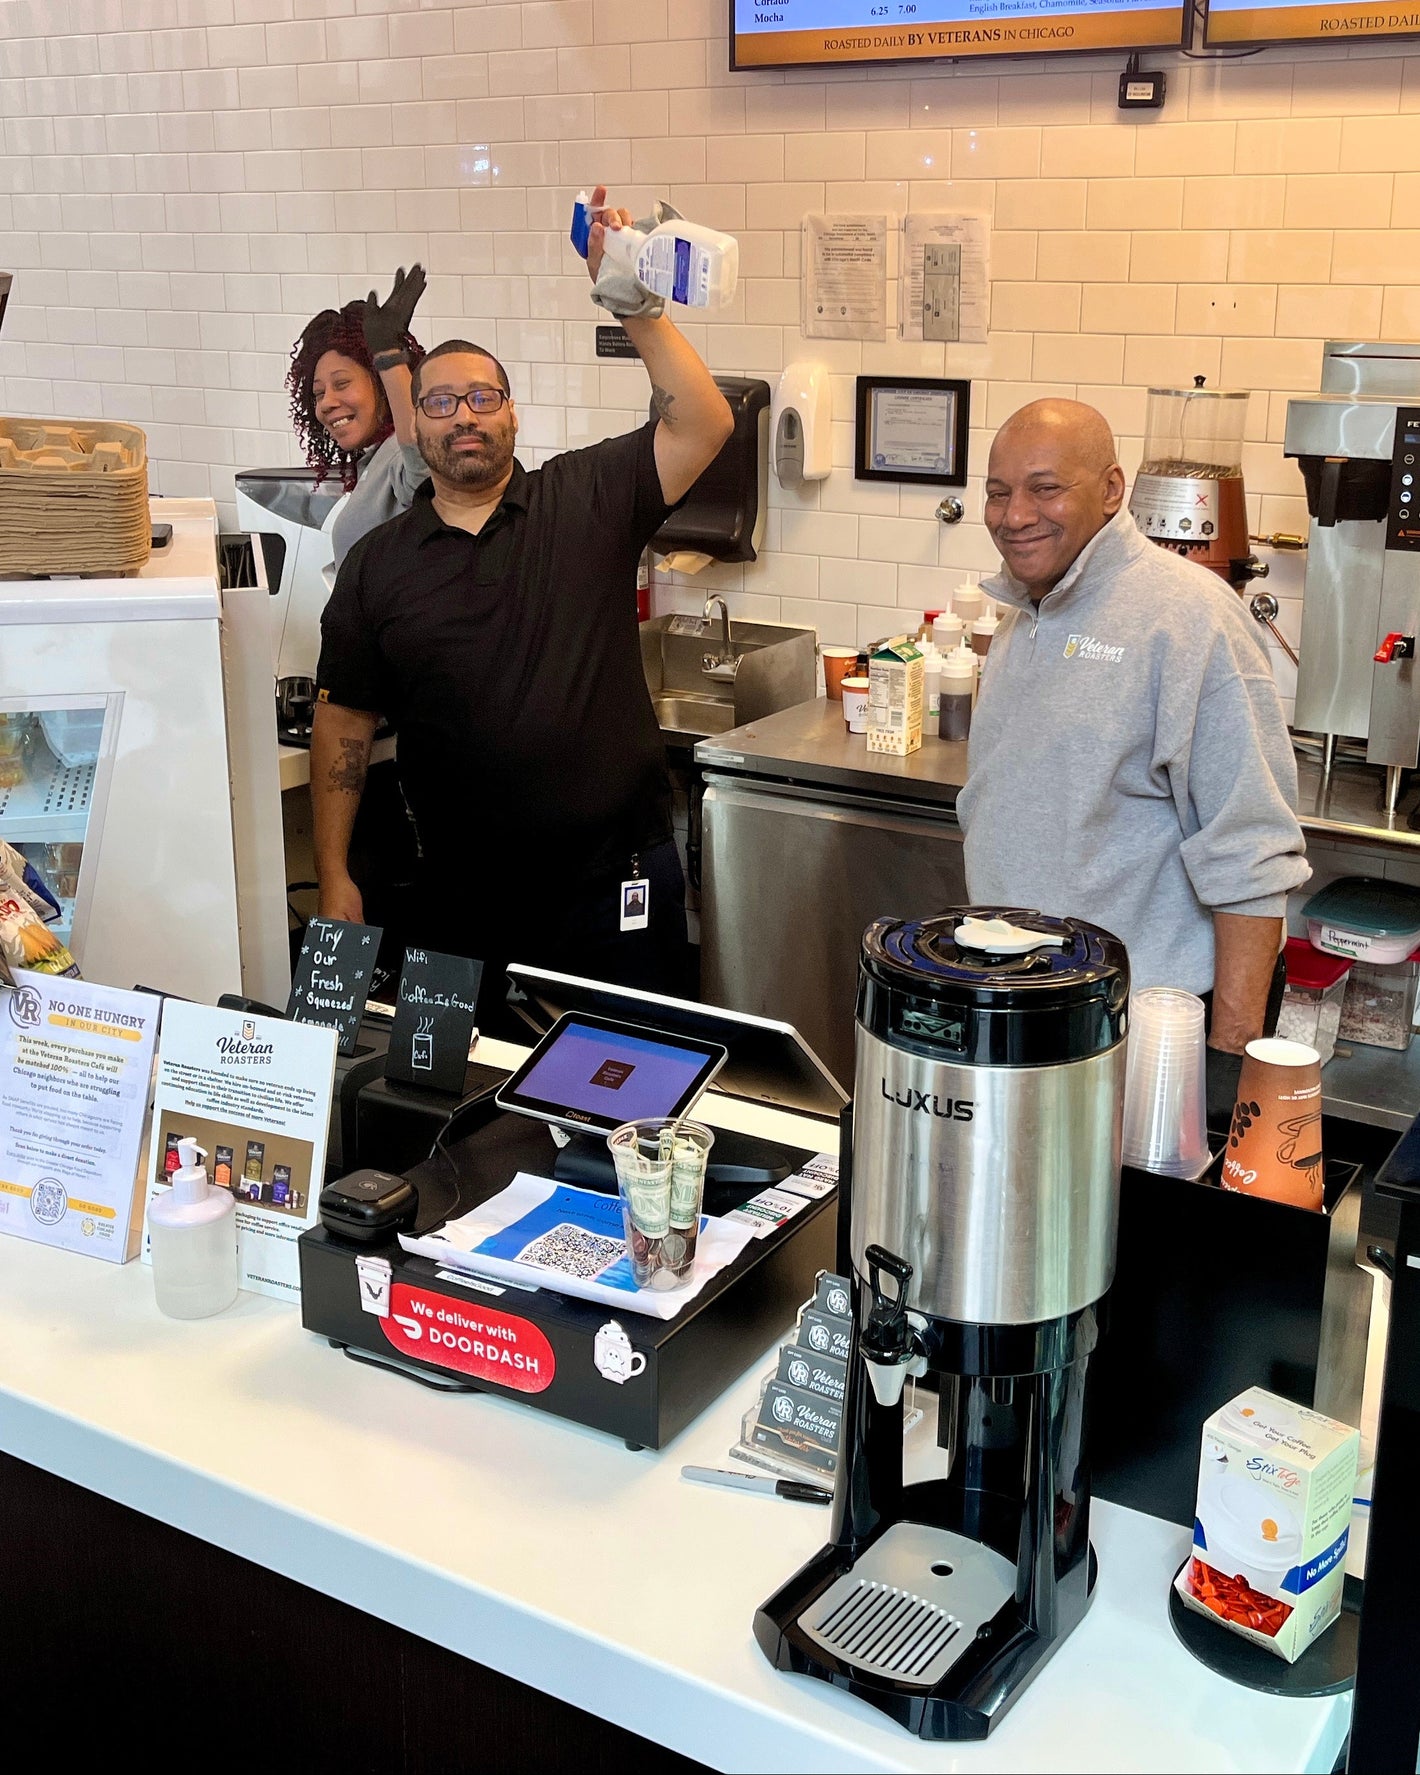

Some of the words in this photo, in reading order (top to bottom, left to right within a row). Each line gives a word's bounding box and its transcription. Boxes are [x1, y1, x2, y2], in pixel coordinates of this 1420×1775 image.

[754, 12, 784, 23] Mocha
[871, 6, 889, 17] 6.25
[898, 4, 917, 15] 7.00
[969, 4, 998, 14] English
[1000, 1, 1037, 11] Breakfast,
[1319, 16, 1385, 31] ROASTED
[1388, 14, 1420, 27] DAIL
[823, 38, 872, 50] ROASTED
[873, 36, 906, 48] DAILY
[907, 33, 925, 46] BY
[927, 28, 1001, 46] VETERANS
[1003, 29, 1017, 40] IN
[1019, 26, 1075, 40] CHICAGO
[1078, 650, 1122, 663] ROASTERS
[1079, 636, 1125, 656] Veteran
[316, 922, 344, 952] Try
[1328, 930, 1369, 949] Peppermint
[313, 950, 337, 966] Our
[406, 949, 428, 965] Wifi
[311, 970, 343, 992] Fresh
[306, 991, 355, 1011] Squeezed
[48, 999, 66, 1013] NO
[67, 1004, 92, 1018] ONE
[93, 1009, 146, 1030] HUNGRY
[65, 1018, 76, 1027] IN
[79, 1020, 98, 1032] OUR
[101, 1025, 124, 1037] CITY
[19, 1034, 32, 1044] This
[33, 1039, 50, 1048] week,
[50, 1043, 67, 1053] every
[67, 1046, 95, 1058] purchase
[96, 1052, 107, 1060] you
[107, 1055, 124, 1064] make
[216, 1036, 275, 1055] Veteran
[17, 1056, 24, 1064] be
[25, 1058, 50, 1070] matched
[50, 1063, 69, 1074] 100%
[78, 1070, 87, 1078] all
[87, 1072, 94, 1080] to
[94, 1074, 108, 1084] help
[29, 1048, 39, 1057] the
[40, 1050, 63, 1061] Veteran
[64, 1055, 90, 1068] Roasters
[106, 1065, 118, 1074] will
[163, 1060, 181, 1068] Veteran
[180, 1063, 201, 1072] Roasters
[220, 1055, 272, 1065] ROASTERS
[12, 1066, 36, 1078] Chicago
[37, 1071, 66, 1084] neighbors
[66, 1079, 79, 1087] who
[79, 1082, 90, 1090] are
[90, 1084, 121, 1098] struggling
[30, 1081, 37, 1089] to
[37, 1084, 48, 1092] put
[49, 1085, 63, 1094] food
[71, 1091, 82, 1099] the
[82, 1094, 99, 1103] table.
[881, 1076, 974, 1122] LUXUS
[593, 1199, 622, 1214] Coffe
[410, 1299, 433, 1318] We
[436, 1308, 484, 1332] deliver
[485, 1317, 518, 1343] with
[429, 1327, 539, 1374] DOORDASH
[812, 1368, 845, 1391] Vetera
[809, 1381, 845, 1401] ROASTER
[793, 1417, 835, 1439] ROASTERS
[796, 1405, 837, 1430] Veteran
[1253, 1420, 1268, 1430] Get
[1268, 1426, 1286, 1438] Your
[1286, 1434, 1312, 1450] Coffee
[1264, 1432, 1280, 1443] Get
[1280, 1439, 1298, 1451] Your
[1306, 1567, 1317, 1581] No
[1317, 1555, 1333, 1573] More
